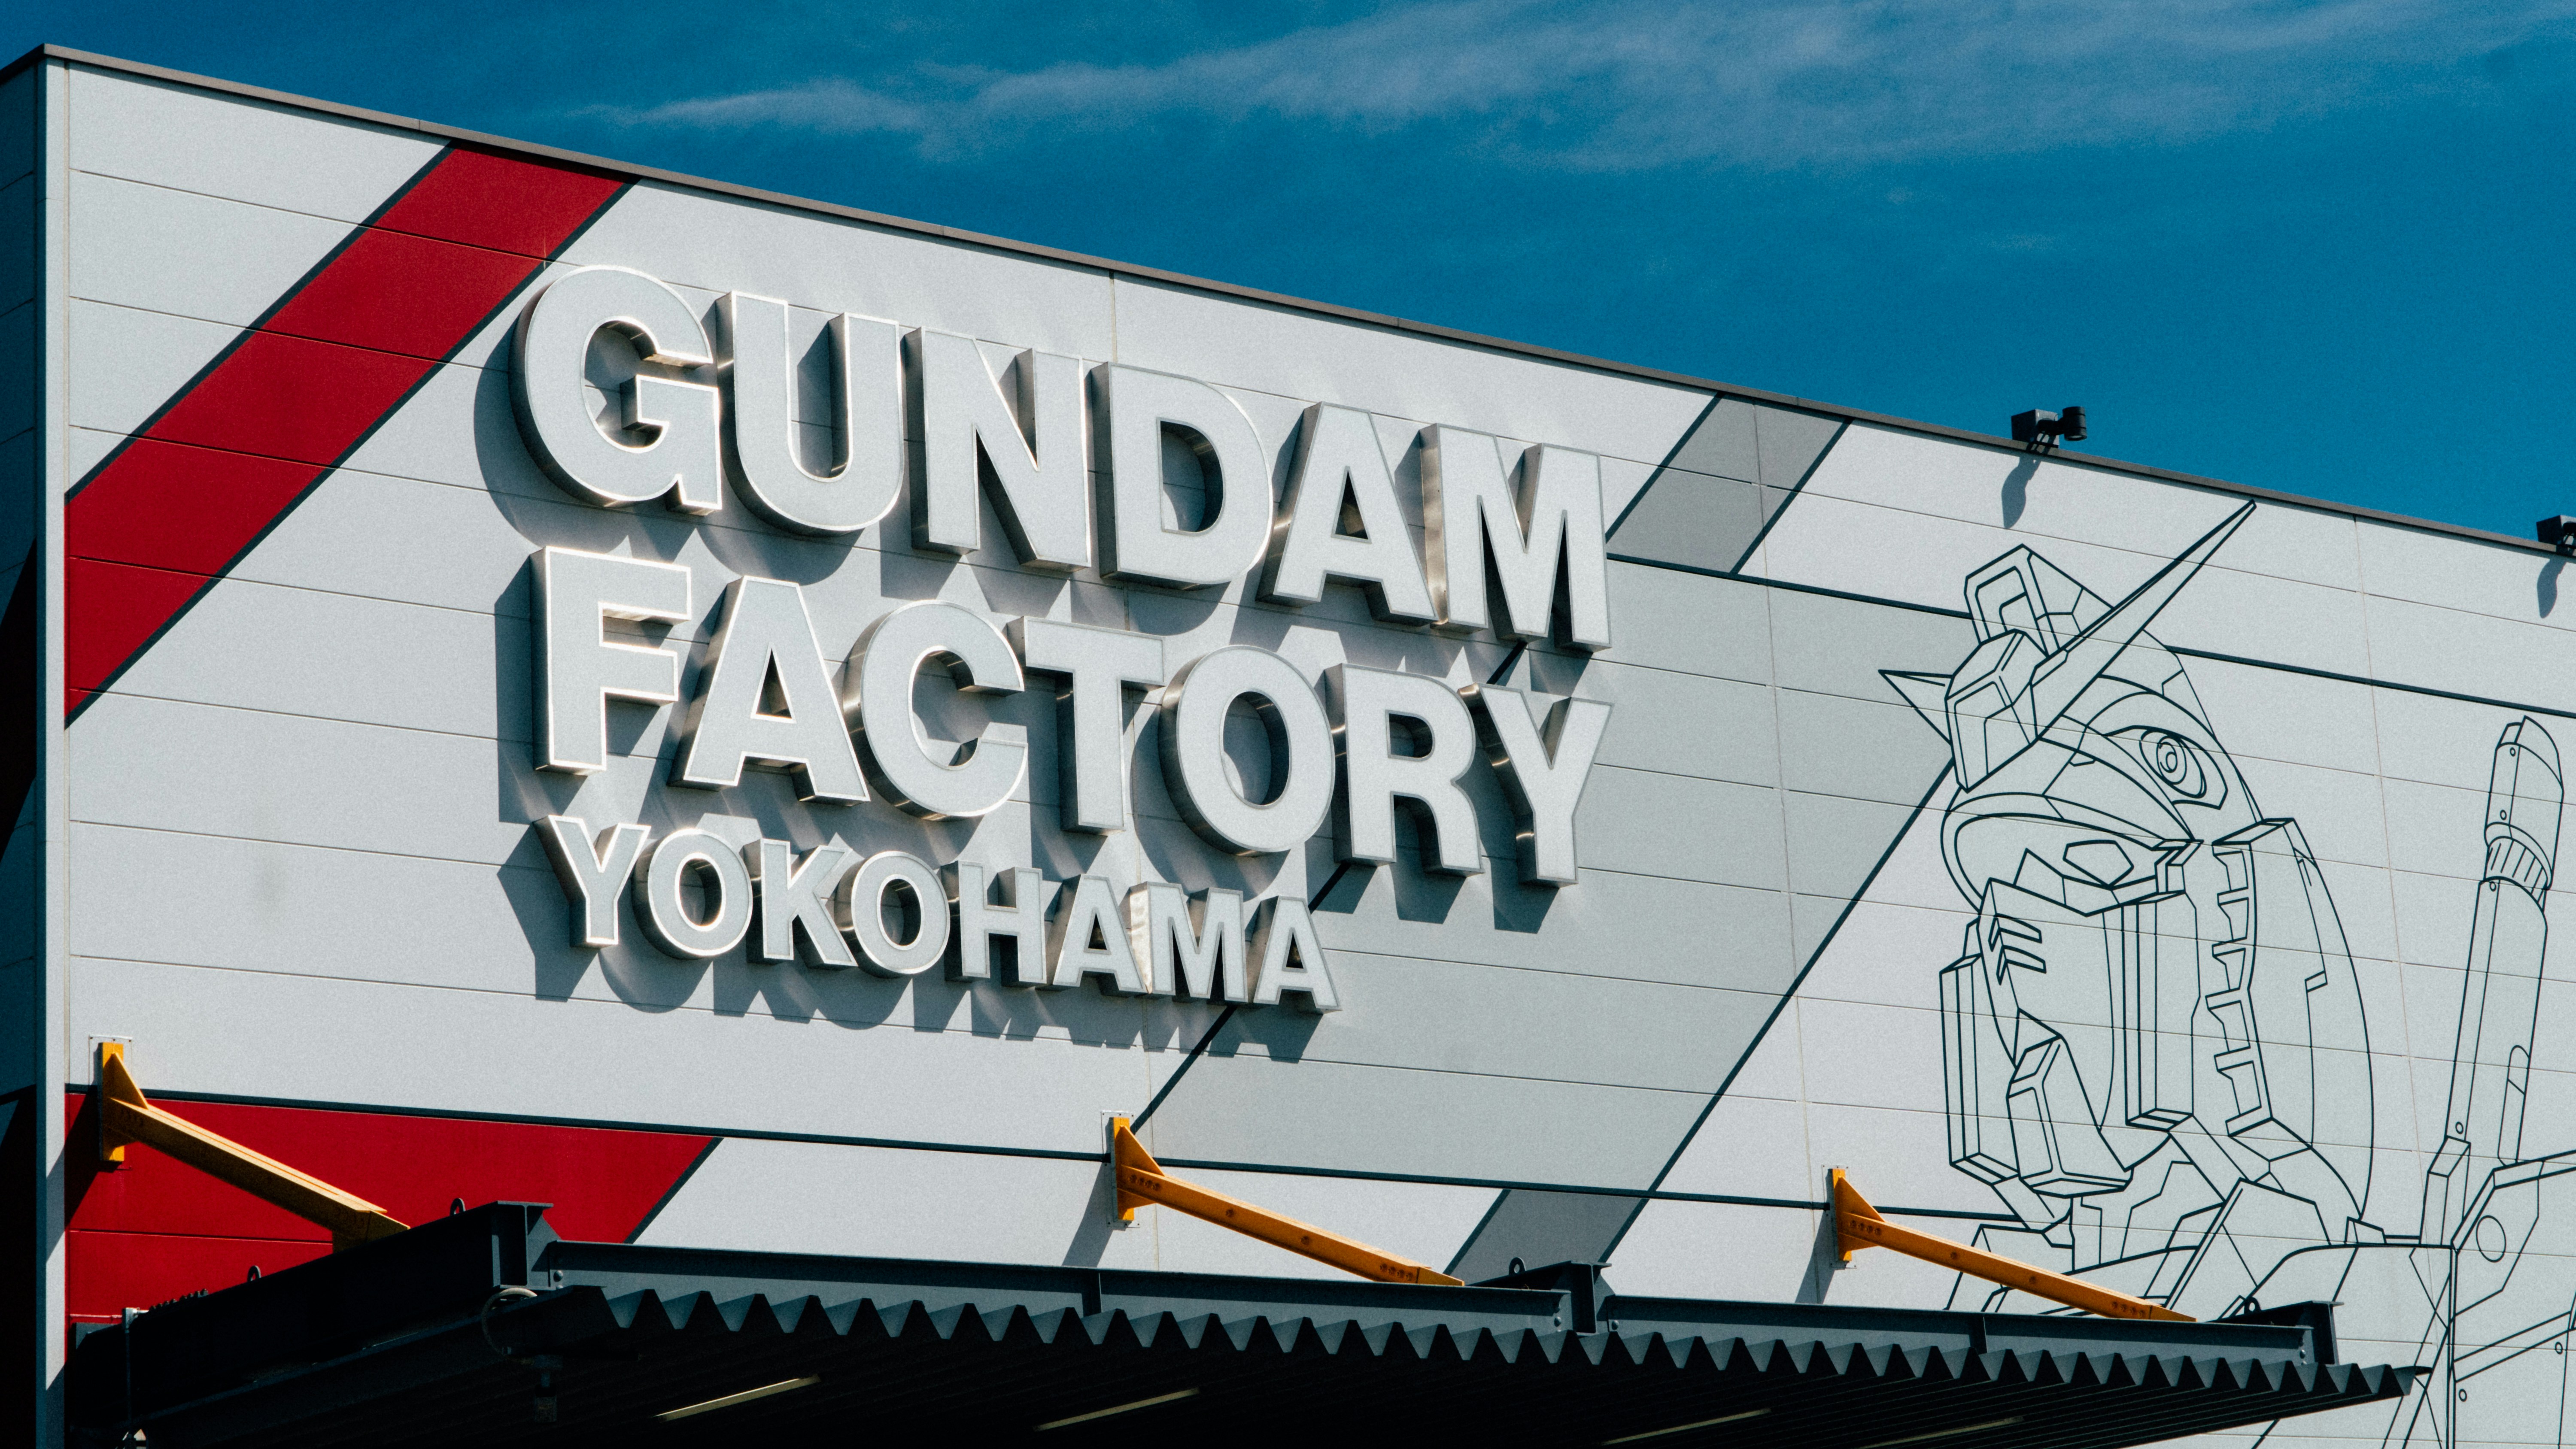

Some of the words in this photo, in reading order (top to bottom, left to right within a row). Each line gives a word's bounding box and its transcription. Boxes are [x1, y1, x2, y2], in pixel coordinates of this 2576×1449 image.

[513, 264, 1611, 650] GUNDAM
[535, 545, 1613, 885] FACTORY
[537, 814, 1340, 1013] YOKOHAMA
